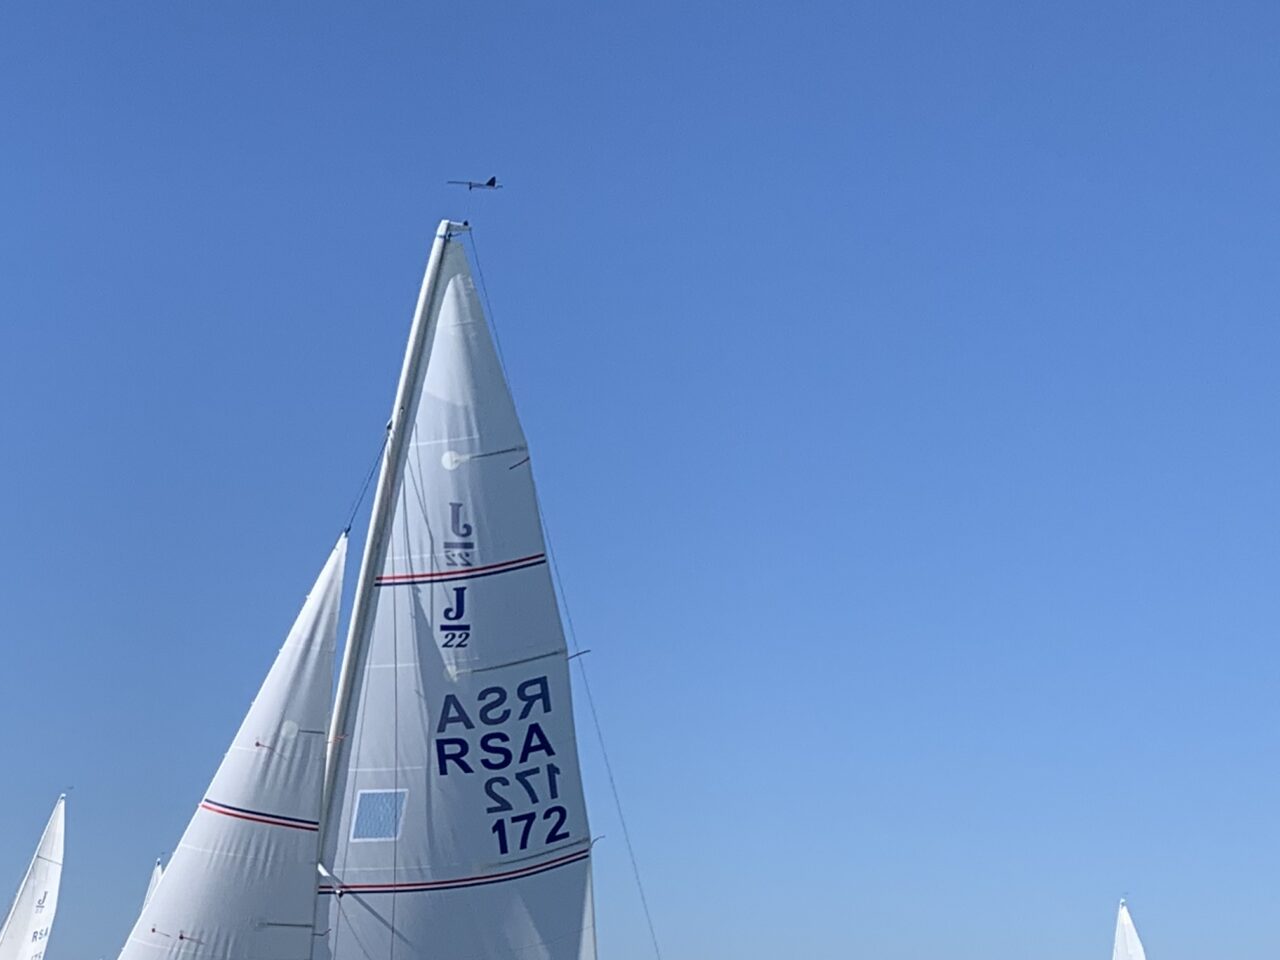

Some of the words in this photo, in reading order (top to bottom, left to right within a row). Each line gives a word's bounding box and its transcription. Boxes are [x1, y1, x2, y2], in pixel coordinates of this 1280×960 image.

[443, 586, 467, 621] J
[442, 632, 470, 648] 22
[435, 722, 555, 776] RSA
[491, 805, 570, 855] 172
[37, 891, 48, 905] J
